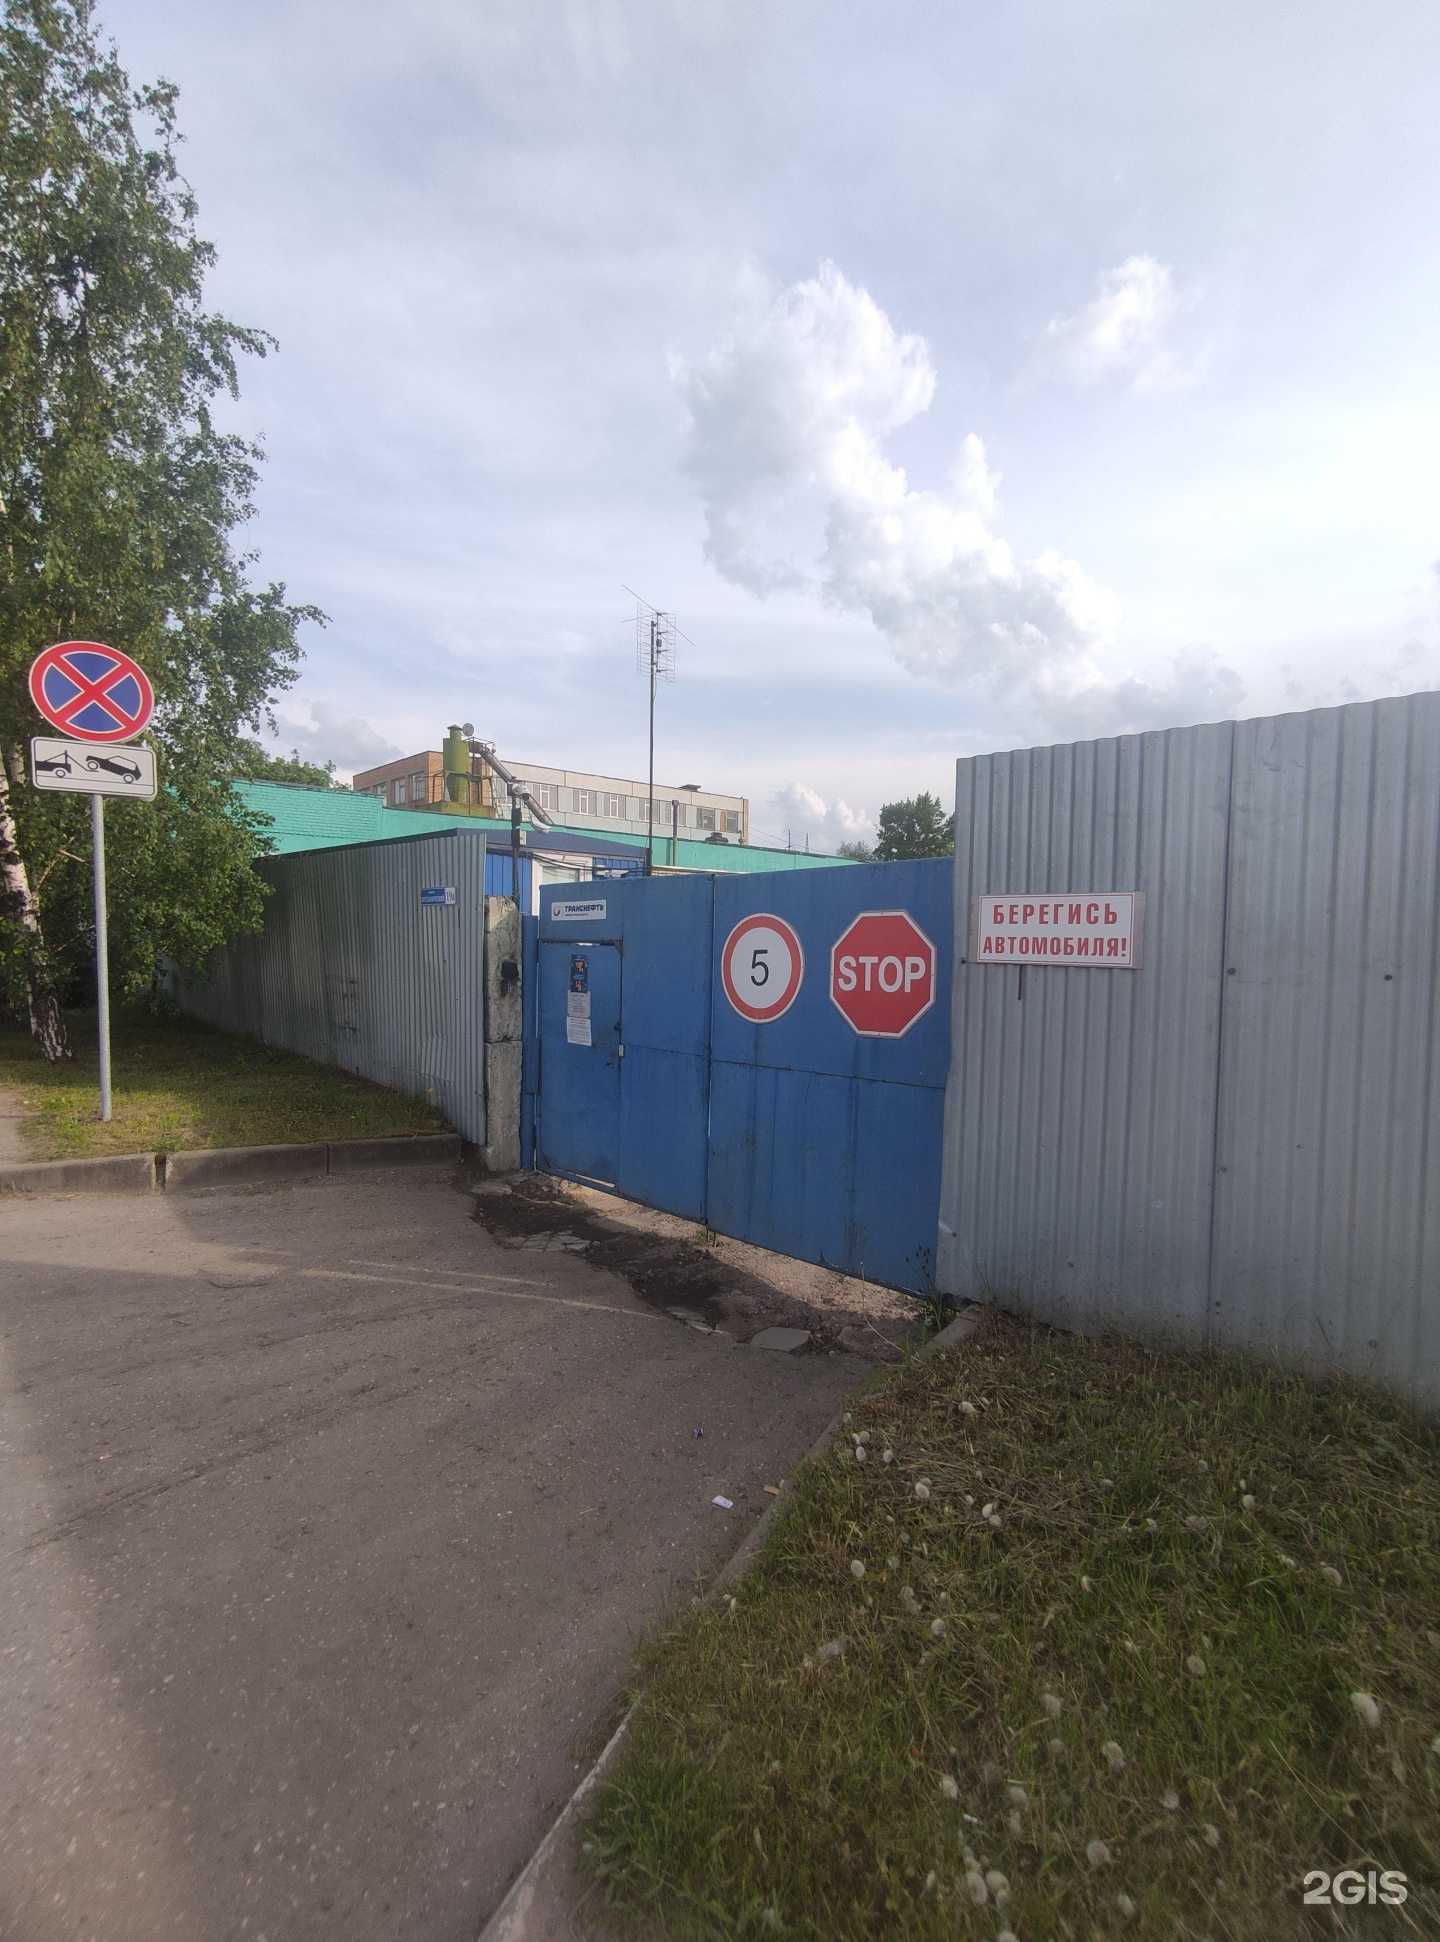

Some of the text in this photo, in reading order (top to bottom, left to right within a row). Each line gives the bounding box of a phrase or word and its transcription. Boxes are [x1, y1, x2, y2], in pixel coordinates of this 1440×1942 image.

[564, 904, 604, 913] ТРАНСНЕФТЬ
[992, 903, 1118, 925] БЕРЕГИСЬ
[983, 936, 1127, 957] АВТОМОБИЛЯ!
[751, 949, 769, 986] 5
[838, 955, 926, 993] STOP
